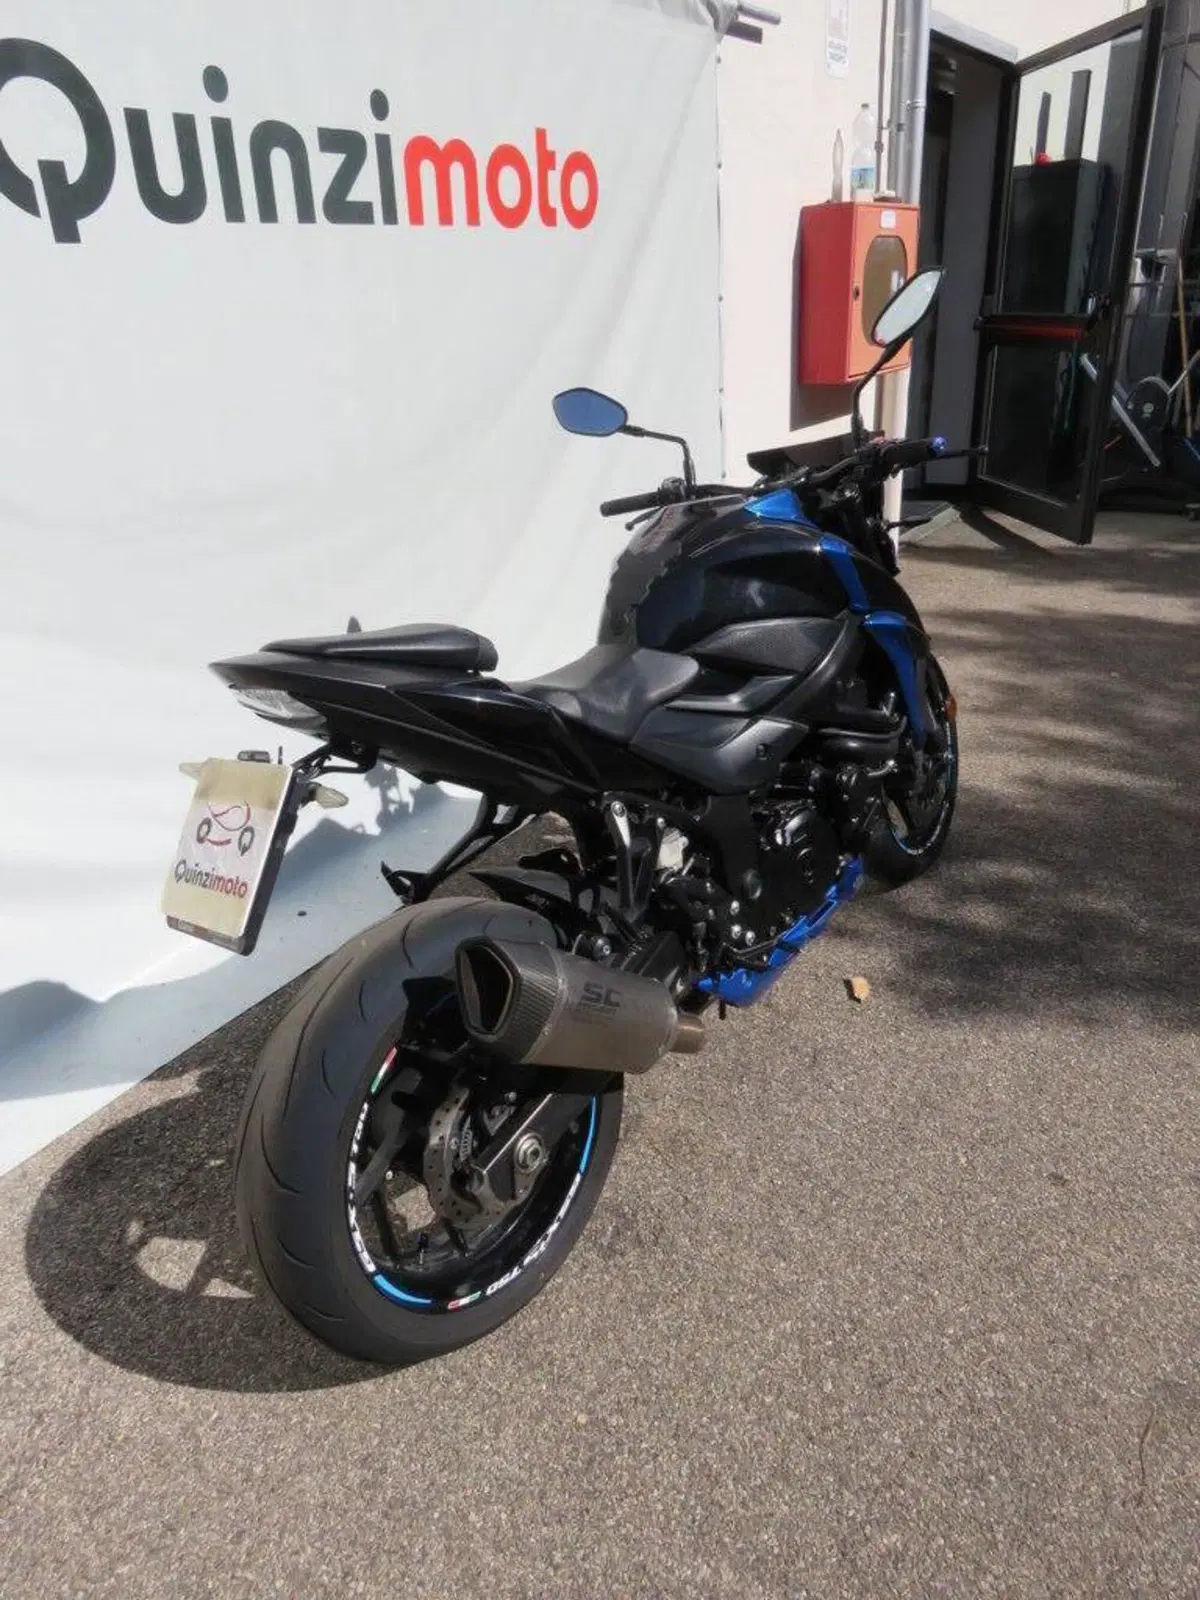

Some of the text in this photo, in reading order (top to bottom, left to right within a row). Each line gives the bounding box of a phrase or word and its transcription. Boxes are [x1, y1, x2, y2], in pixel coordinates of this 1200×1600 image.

[0, 37, 599, 244] Quinzimoto
[175, 859, 248, 898] Quinzimoto
[581, 981, 622, 1007] SC
